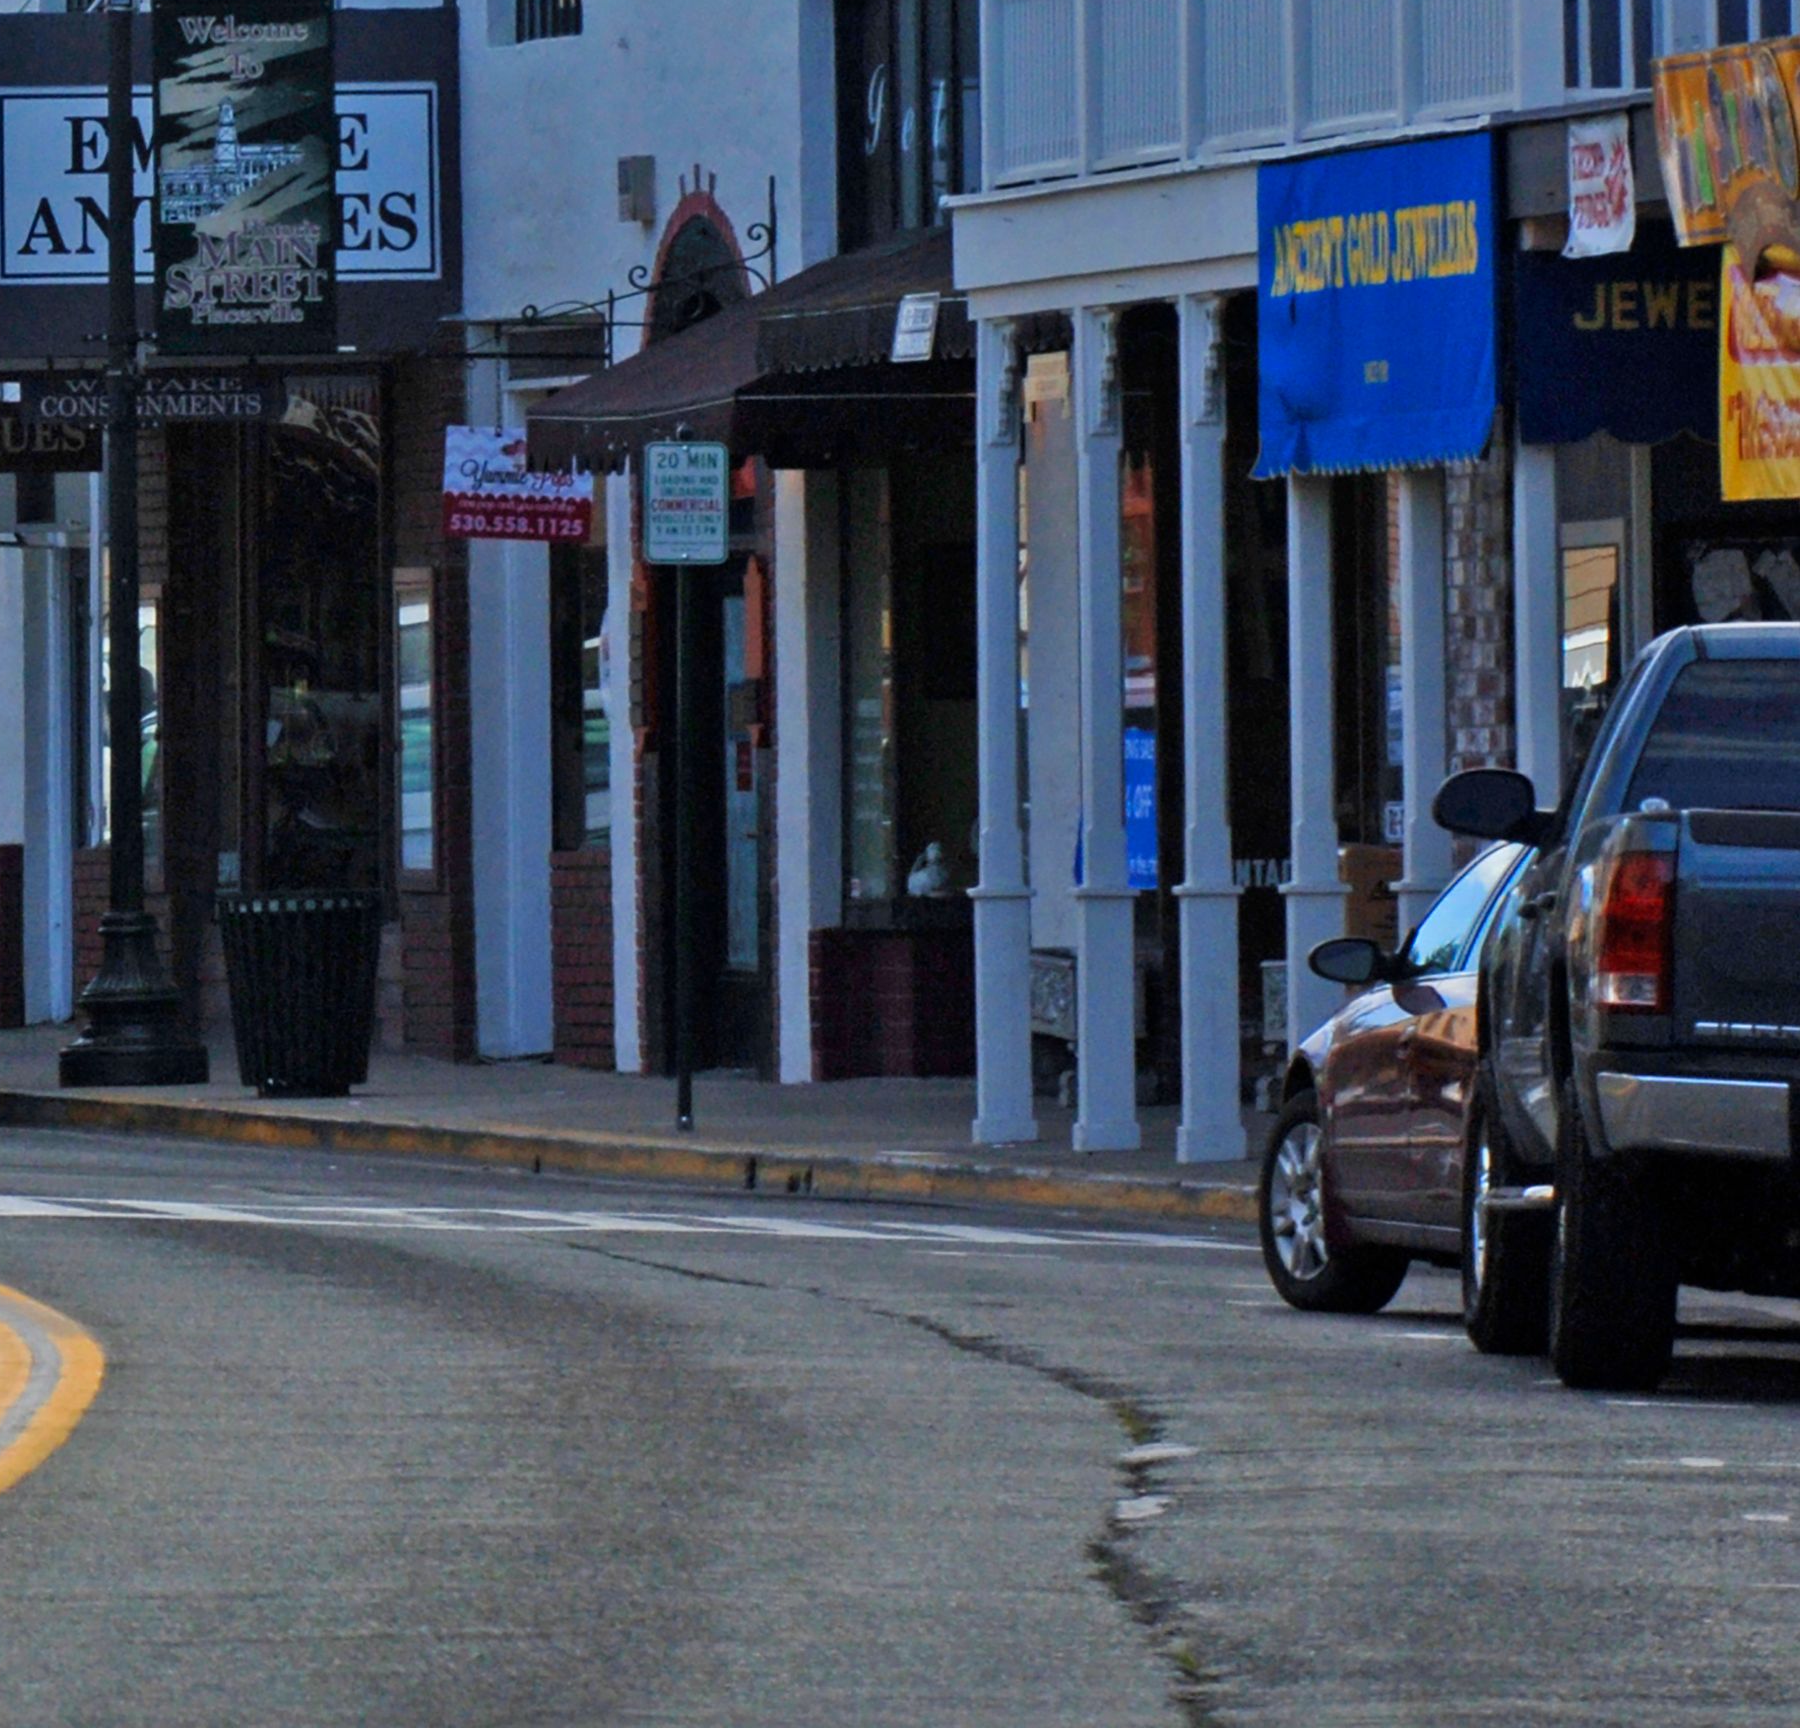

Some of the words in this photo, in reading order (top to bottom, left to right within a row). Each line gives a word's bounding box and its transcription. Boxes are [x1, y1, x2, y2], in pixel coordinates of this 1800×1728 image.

[177, 17, 308, 44] Welcome
[197, 231, 321, 270] MAIN
[163, 267, 329, 309] STREET
[656, 453, 680, 470] 20
[687, 452, 718, 469] MIN
[651, 498, 723, 512] COMMERCIAL
[449, 513, 584, 536] 530.558.1125
